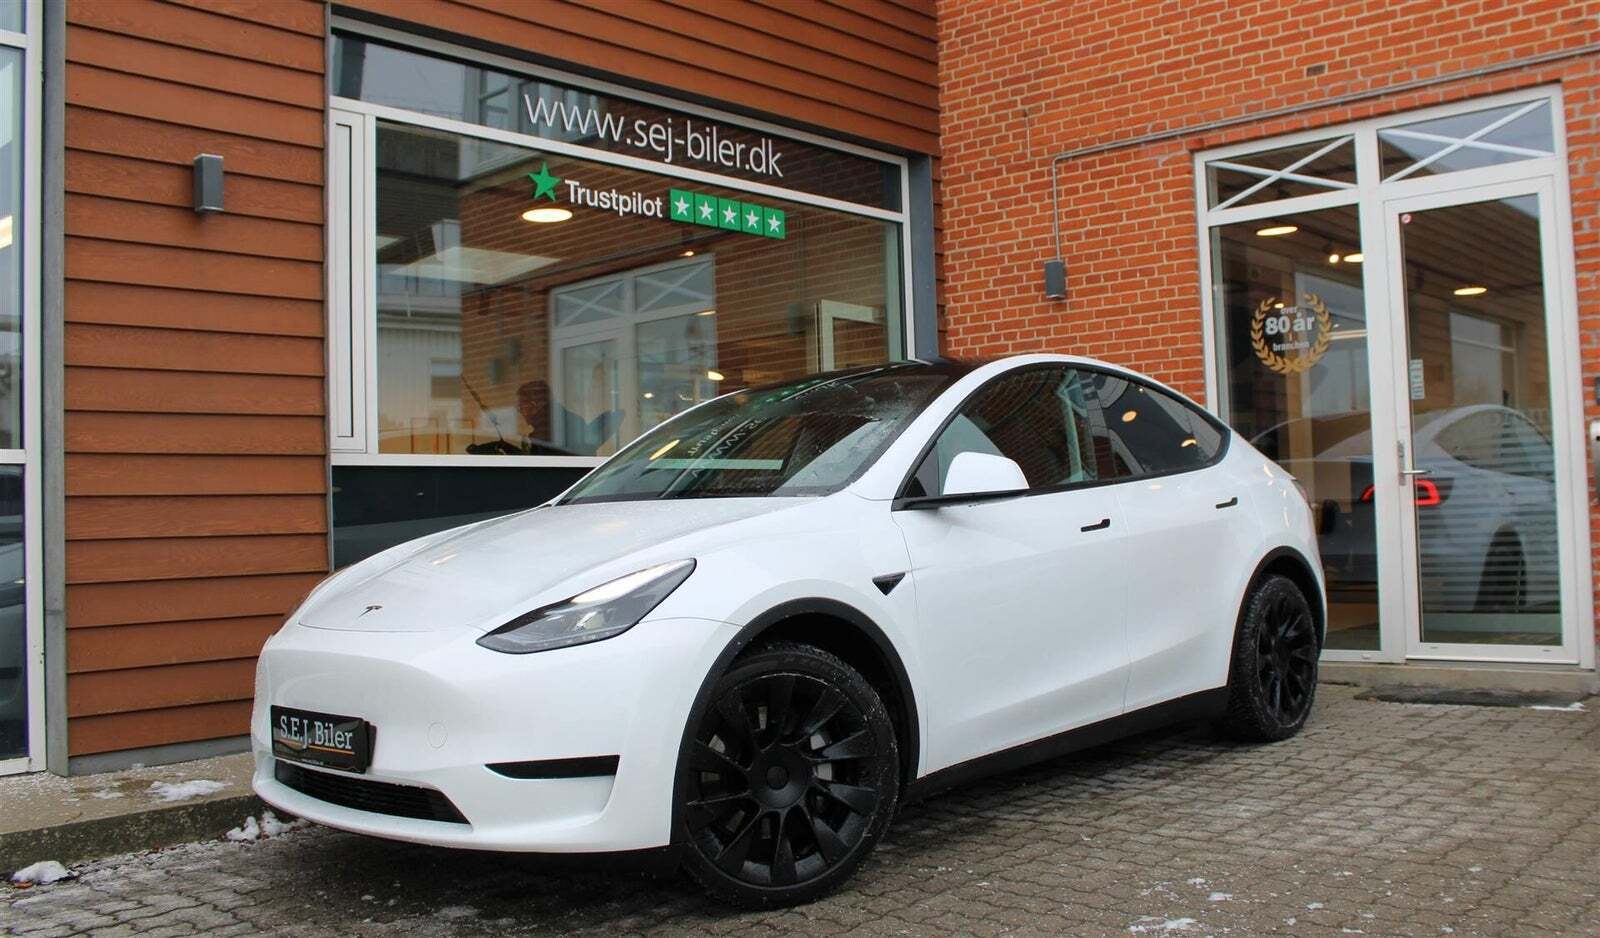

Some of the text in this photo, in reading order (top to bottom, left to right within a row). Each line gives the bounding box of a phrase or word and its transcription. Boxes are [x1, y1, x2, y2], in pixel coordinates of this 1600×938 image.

[524, 93, 784, 177] www.sej-biler.dk
[564, 179, 664, 218] Trustpilot
[1265, 312, 1315, 335] 80 år
[280, 715, 353, 749] S.E.J. Biler
